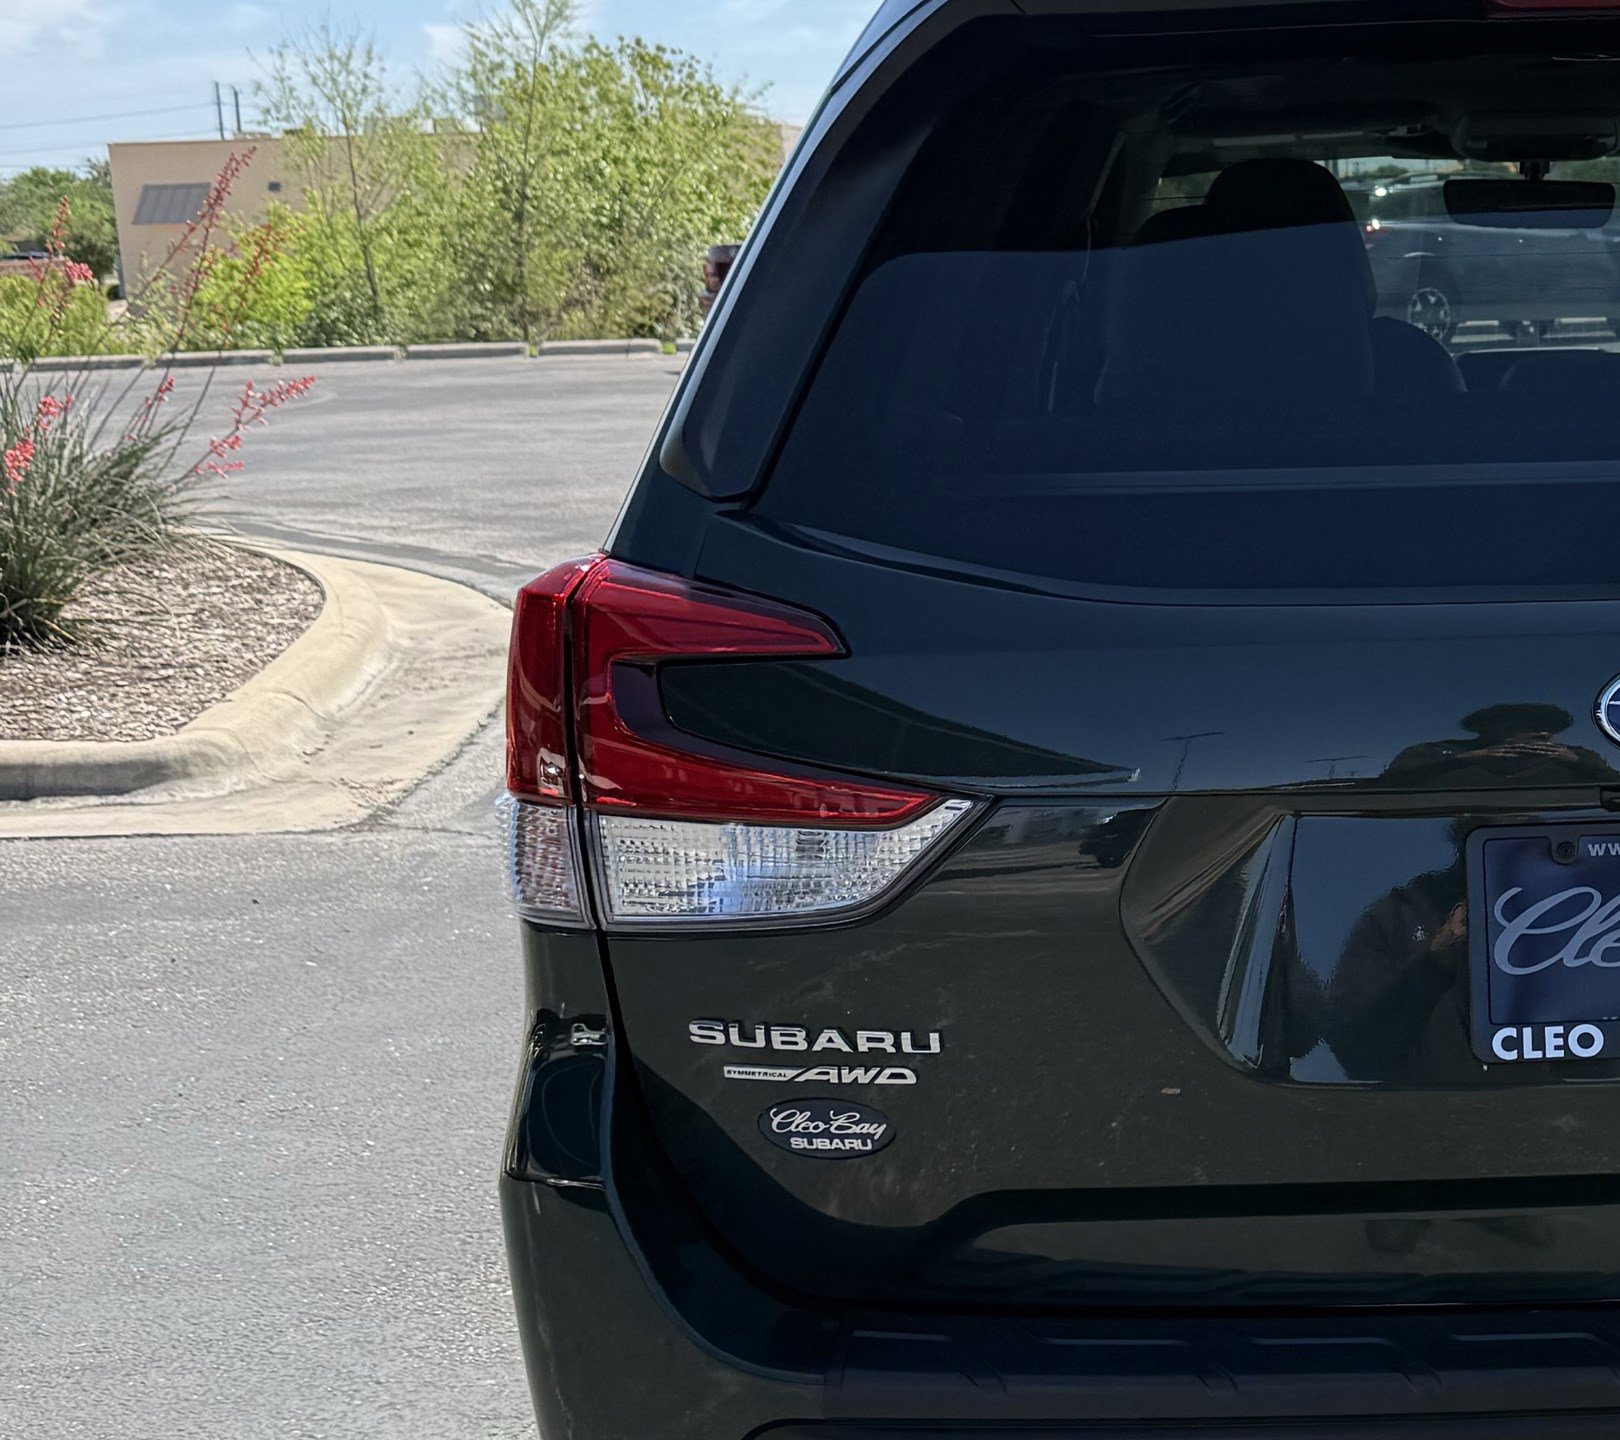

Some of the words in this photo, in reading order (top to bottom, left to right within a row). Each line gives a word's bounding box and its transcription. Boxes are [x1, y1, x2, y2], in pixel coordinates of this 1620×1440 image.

[688, 1019, 941, 1054] SUBARU
[1491, 1023, 1605, 1061] CLEO
[725, 1068, 789, 1079] SYMMETRICAL
[793, 1066, 918, 1085] AWD
[769, 1107, 831, 1135] Cleo
[826, 1110, 888, 1140] Bay
[789, 1137, 873, 1151] SUBARU
